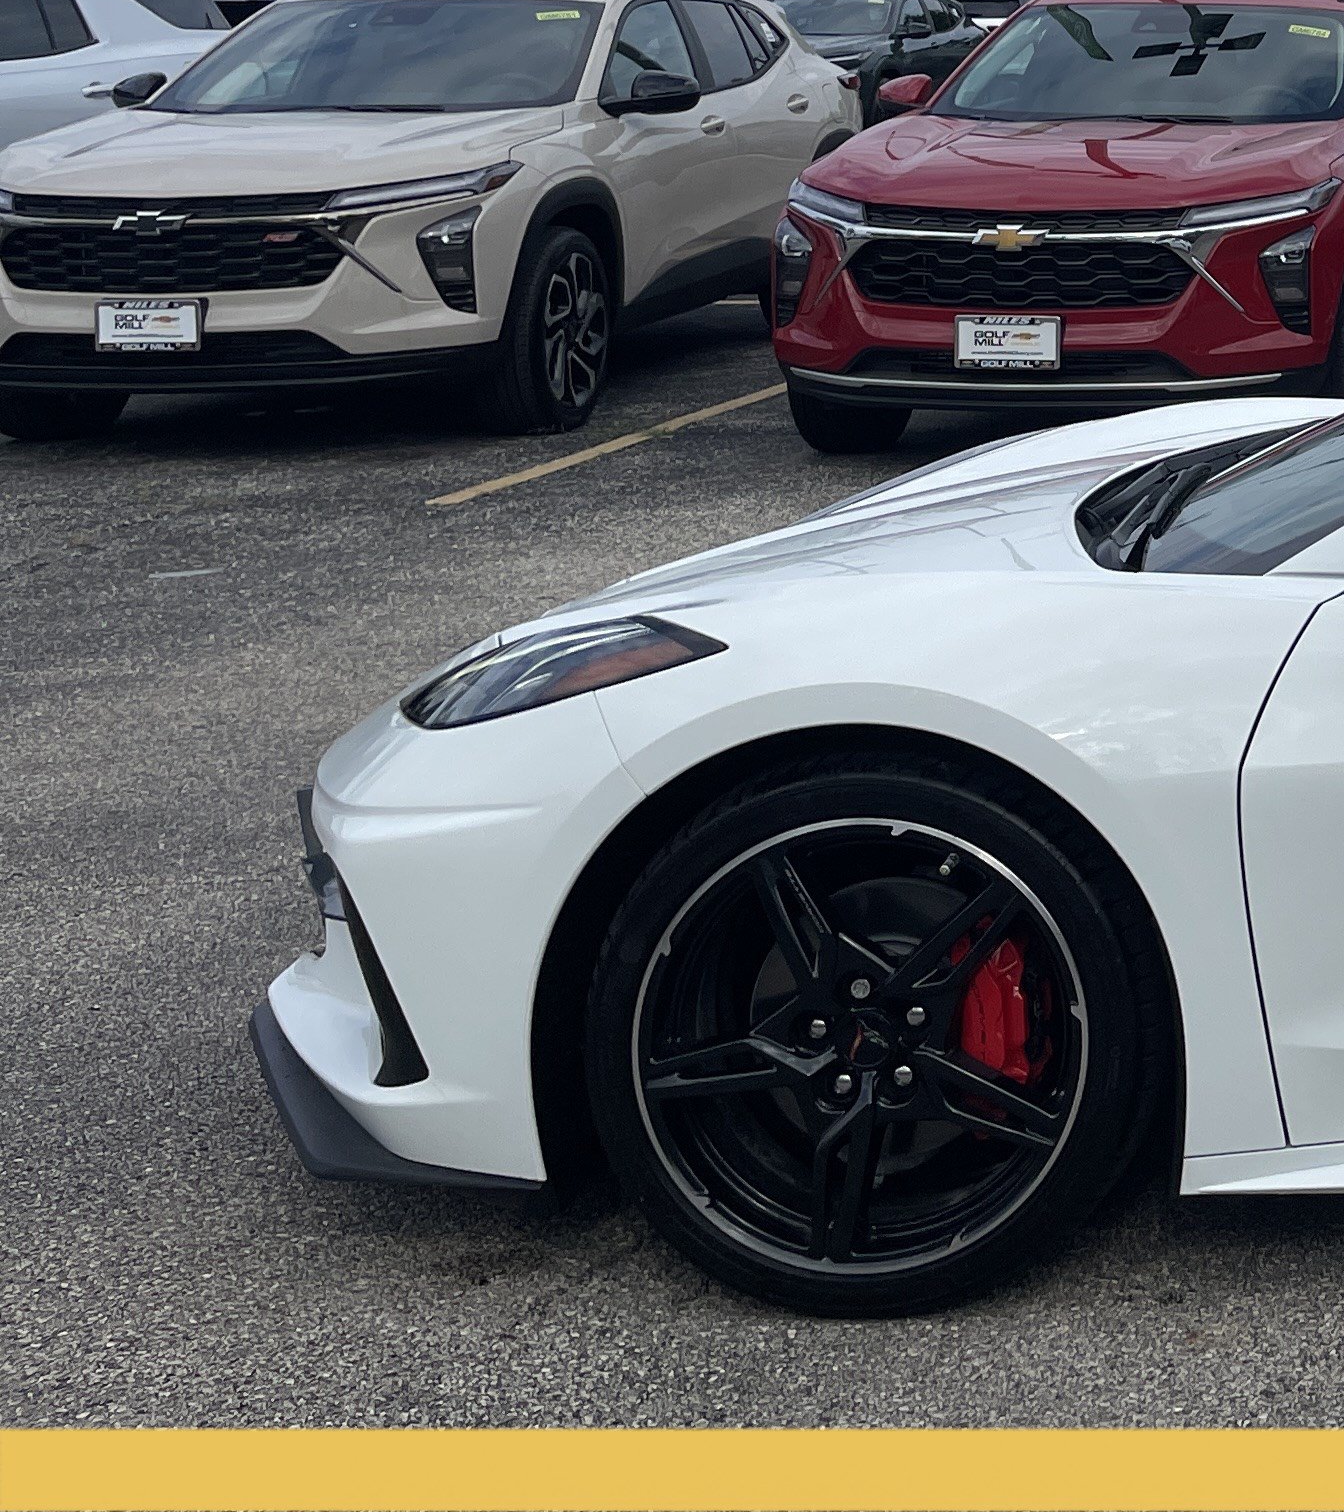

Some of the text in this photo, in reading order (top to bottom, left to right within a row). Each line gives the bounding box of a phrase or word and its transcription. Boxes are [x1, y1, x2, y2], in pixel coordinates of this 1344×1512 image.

[114, 314, 150, 322] GOLF
[114, 321, 143, 329] MILL
[974, 331, 1010, 339] GOLF
[974, 338, 1003, 347] MILL
[980, 360, 1034, 368] GOLF MILL
